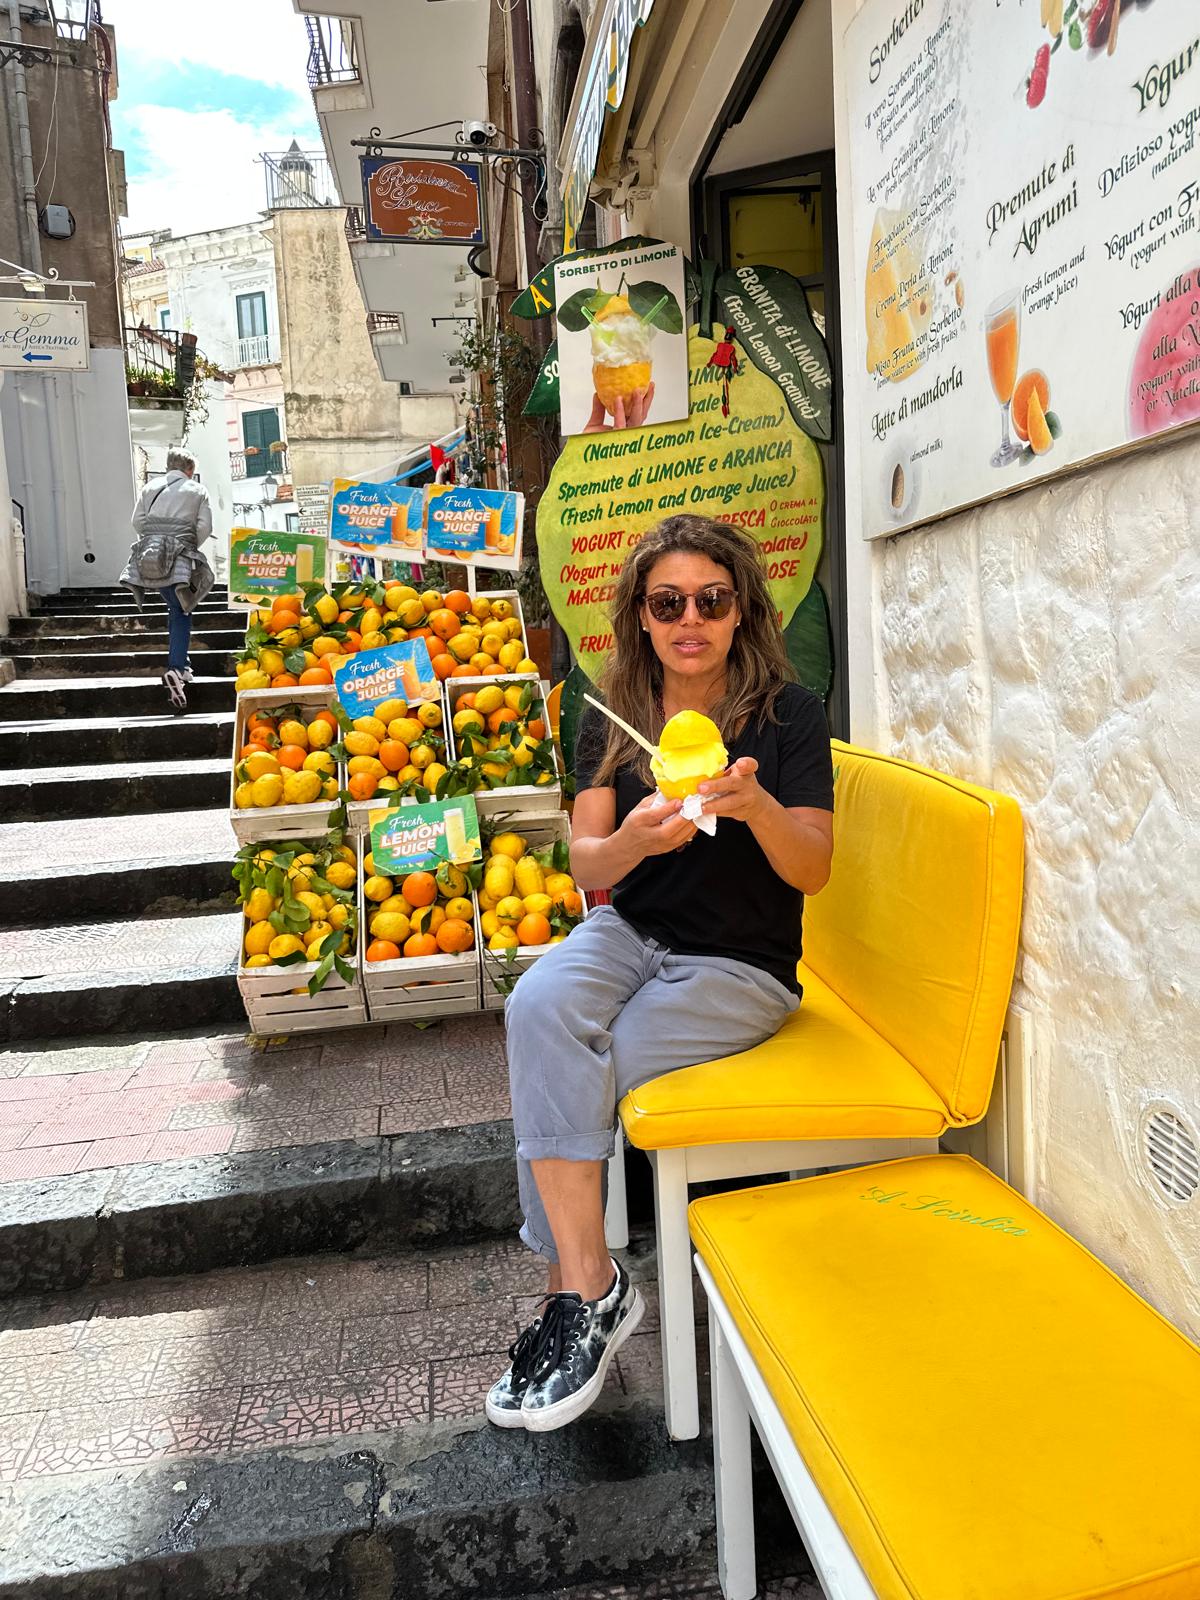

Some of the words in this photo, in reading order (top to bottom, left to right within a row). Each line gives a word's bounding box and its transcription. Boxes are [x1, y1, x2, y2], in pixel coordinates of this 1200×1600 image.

[1098, 135, 1163, 198] Delizioso
[986, 160, 1057, 246] Premute
[1062, 143, 1076, 173] di
[1013, 180, 1078, 259] Agrumi
[1104, 222, 1145, 261] Yogurt
[1149, 205, 1173, 231] con
[1130, 232, 1168, 270] (yogurt
[1170, 213, 1196, 239] with
[559, 260, 618, 279] SORBETTO
[620, 257, 632, 268] DI
[634, 248, 677, 265] LIMONE
[1044, 262, 1068, 286] lemon
[1069, 245, 1086, 268] and
[736, 266, 784, 325] GRANITA
[1028, 290, 1055, 315] orange
[1054, 275, 1078, 304] juice)
[1119, 291, 1161, 330] Yogurt
[1165, 273, 1191, 303] alla
[775, 325, 798, 339] di
[929, 307, 962, 343] Sorbetto
[5, 327, 80, 351] Gemma
[1152, 335, 1177, 361] alla
[723, 295, 757, 333] (Fresh
[749, 333, 782, 373] Lemon
[777, 372, 821, 420] Granita)
[784, 338, 832, 391] LIMONE
[872, 411, 896, 442] Latte
[898, 397, 908, 421] di
[910, 363, 963, 415] mandorla
[583, 435, 644, 463] (Natural
[647, 430, 694, 452] Lemon
[700, 406, 785, 441] Ice-Cream)
[558, 475, 624, 503] Spremute
[627, 467, 643, 488] di
[646, 456, 706, 485] LIMONE
[708, 458, 718, 472] e
[722, 439, 793, 470] ARANCIA
[350, 489, 379, 504] Fresh
[444, 495, 474, 508] Fresh
[560, 503, 603, 526] (Fresh
[607, 498, 654, 519] Lemon
[658, 488, 687, 509] and
[690, 482, 742, 505] Orange
[746, 465, 797, 493] Juice)
[769, 499, 777, 511] O
[779, 500, 806, 509] CREMA
[808, 498, 818, 506] AL
[338, 504, 398, 517] ORANGE
[347, 515, 386, 528] JUICE
[433, 510, 491, 522] ORANGE
[442, 522, 479, 533] JUICE
[248, 538, 280, 552] Fresh
[570, 531, 626, 555] YOGURT
[238, 553, 297, 566] LEMON
[247, 566, 288, 577] JUICE
[559, 563, 608, 585] (Yogurt
[342, 665, 405, 693] ORANGE
[349, 658, 382, 675] Fresh
[357, 680, 397, 702] JUICE
[380, 822, 447, 848] LEMON
[388, 814, 424, 831] Fresh
[391, 838, 437, 858] JUICE
